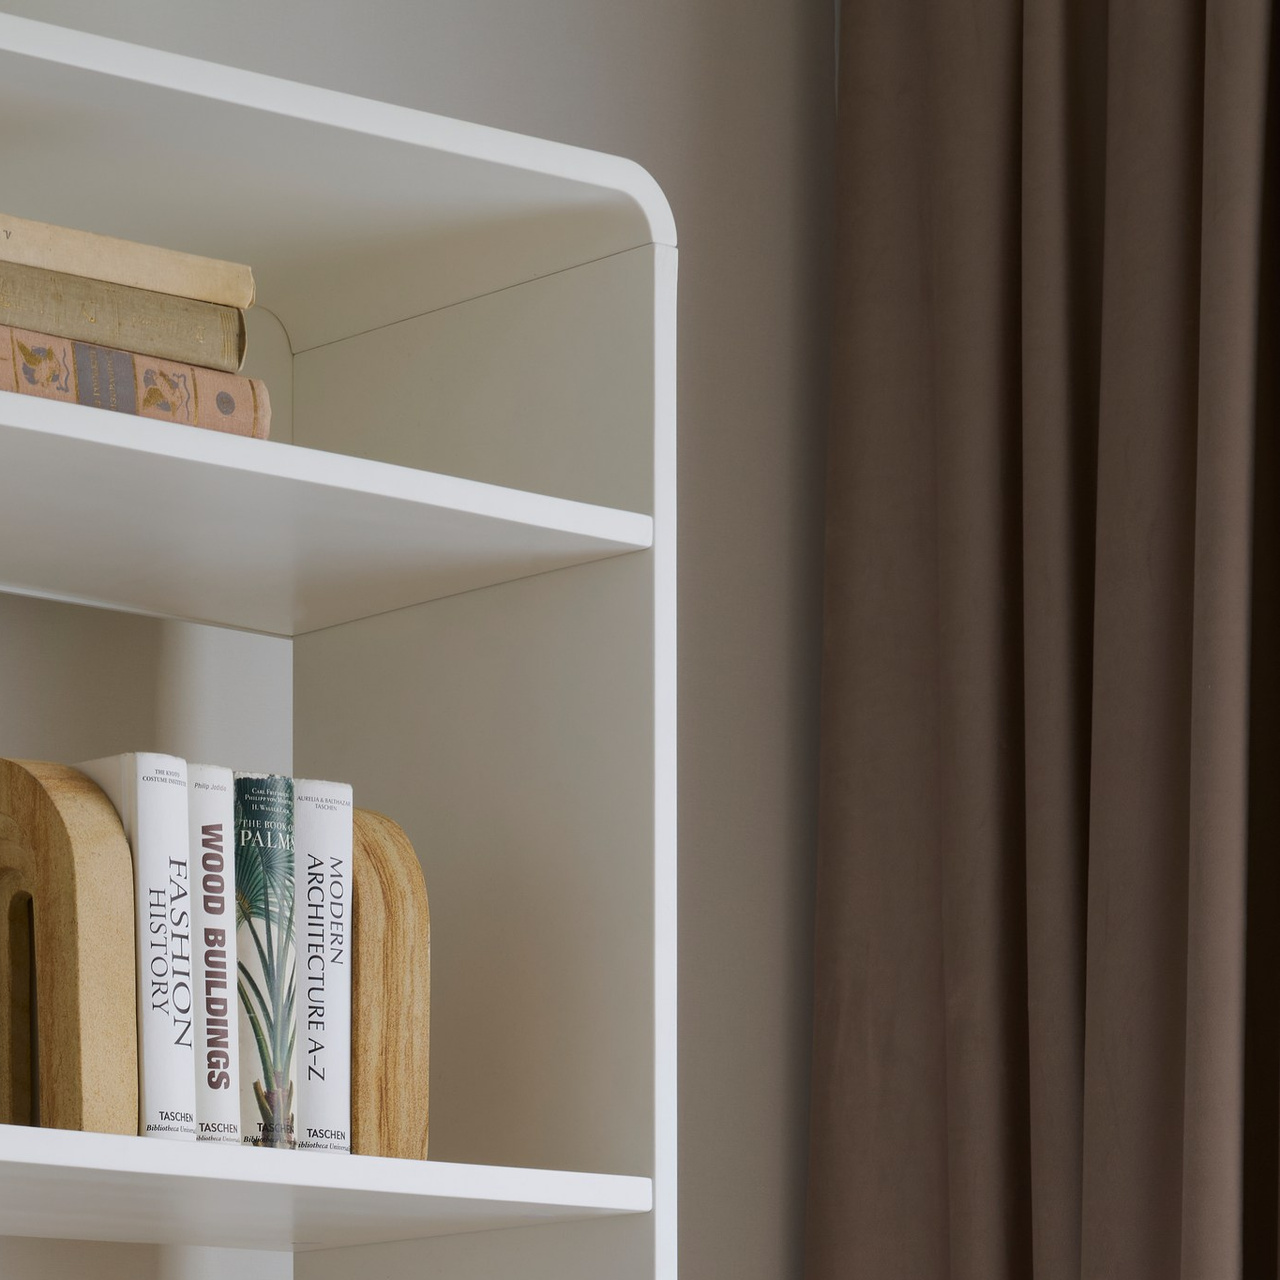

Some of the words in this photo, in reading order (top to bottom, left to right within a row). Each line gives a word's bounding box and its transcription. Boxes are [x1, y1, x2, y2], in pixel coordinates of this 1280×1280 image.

[154, 768, 165, 776] THE
[142, 775, 167, 784] COSTUME
[194, 782, 210, 790] Philip
[241, 819, 262, 828] THE
[264, 820, 287, 831] BOOK
[240, 829, 295, 853] PALMS
[201, 822, 225, 916] WOOD
[329, 856, 344, 965] MODERN
[307, 853, 325, 1031] ARCHITECTURE
[149, 887, 170, 1016] HISTORY
[168, 856, 192, 1048] FASHION
[203, 928, 231, 1091] BUILDINGS
[308, 1037, 325, 1082] A-Z
[158, 1111, 194, 1123] TASCHEN
[146, 1124, 179, 1132] Bibliotheca
[199, 1122, 238, 1134] TASCHEN
[256, 1122, 295, 1134] TASCHEN
[306, 1128, 346, 1140] TASCHEN
[195, 1134, 221, 1142] ibliotheca
[297, 1140, 329, 1149] ibliotheca
